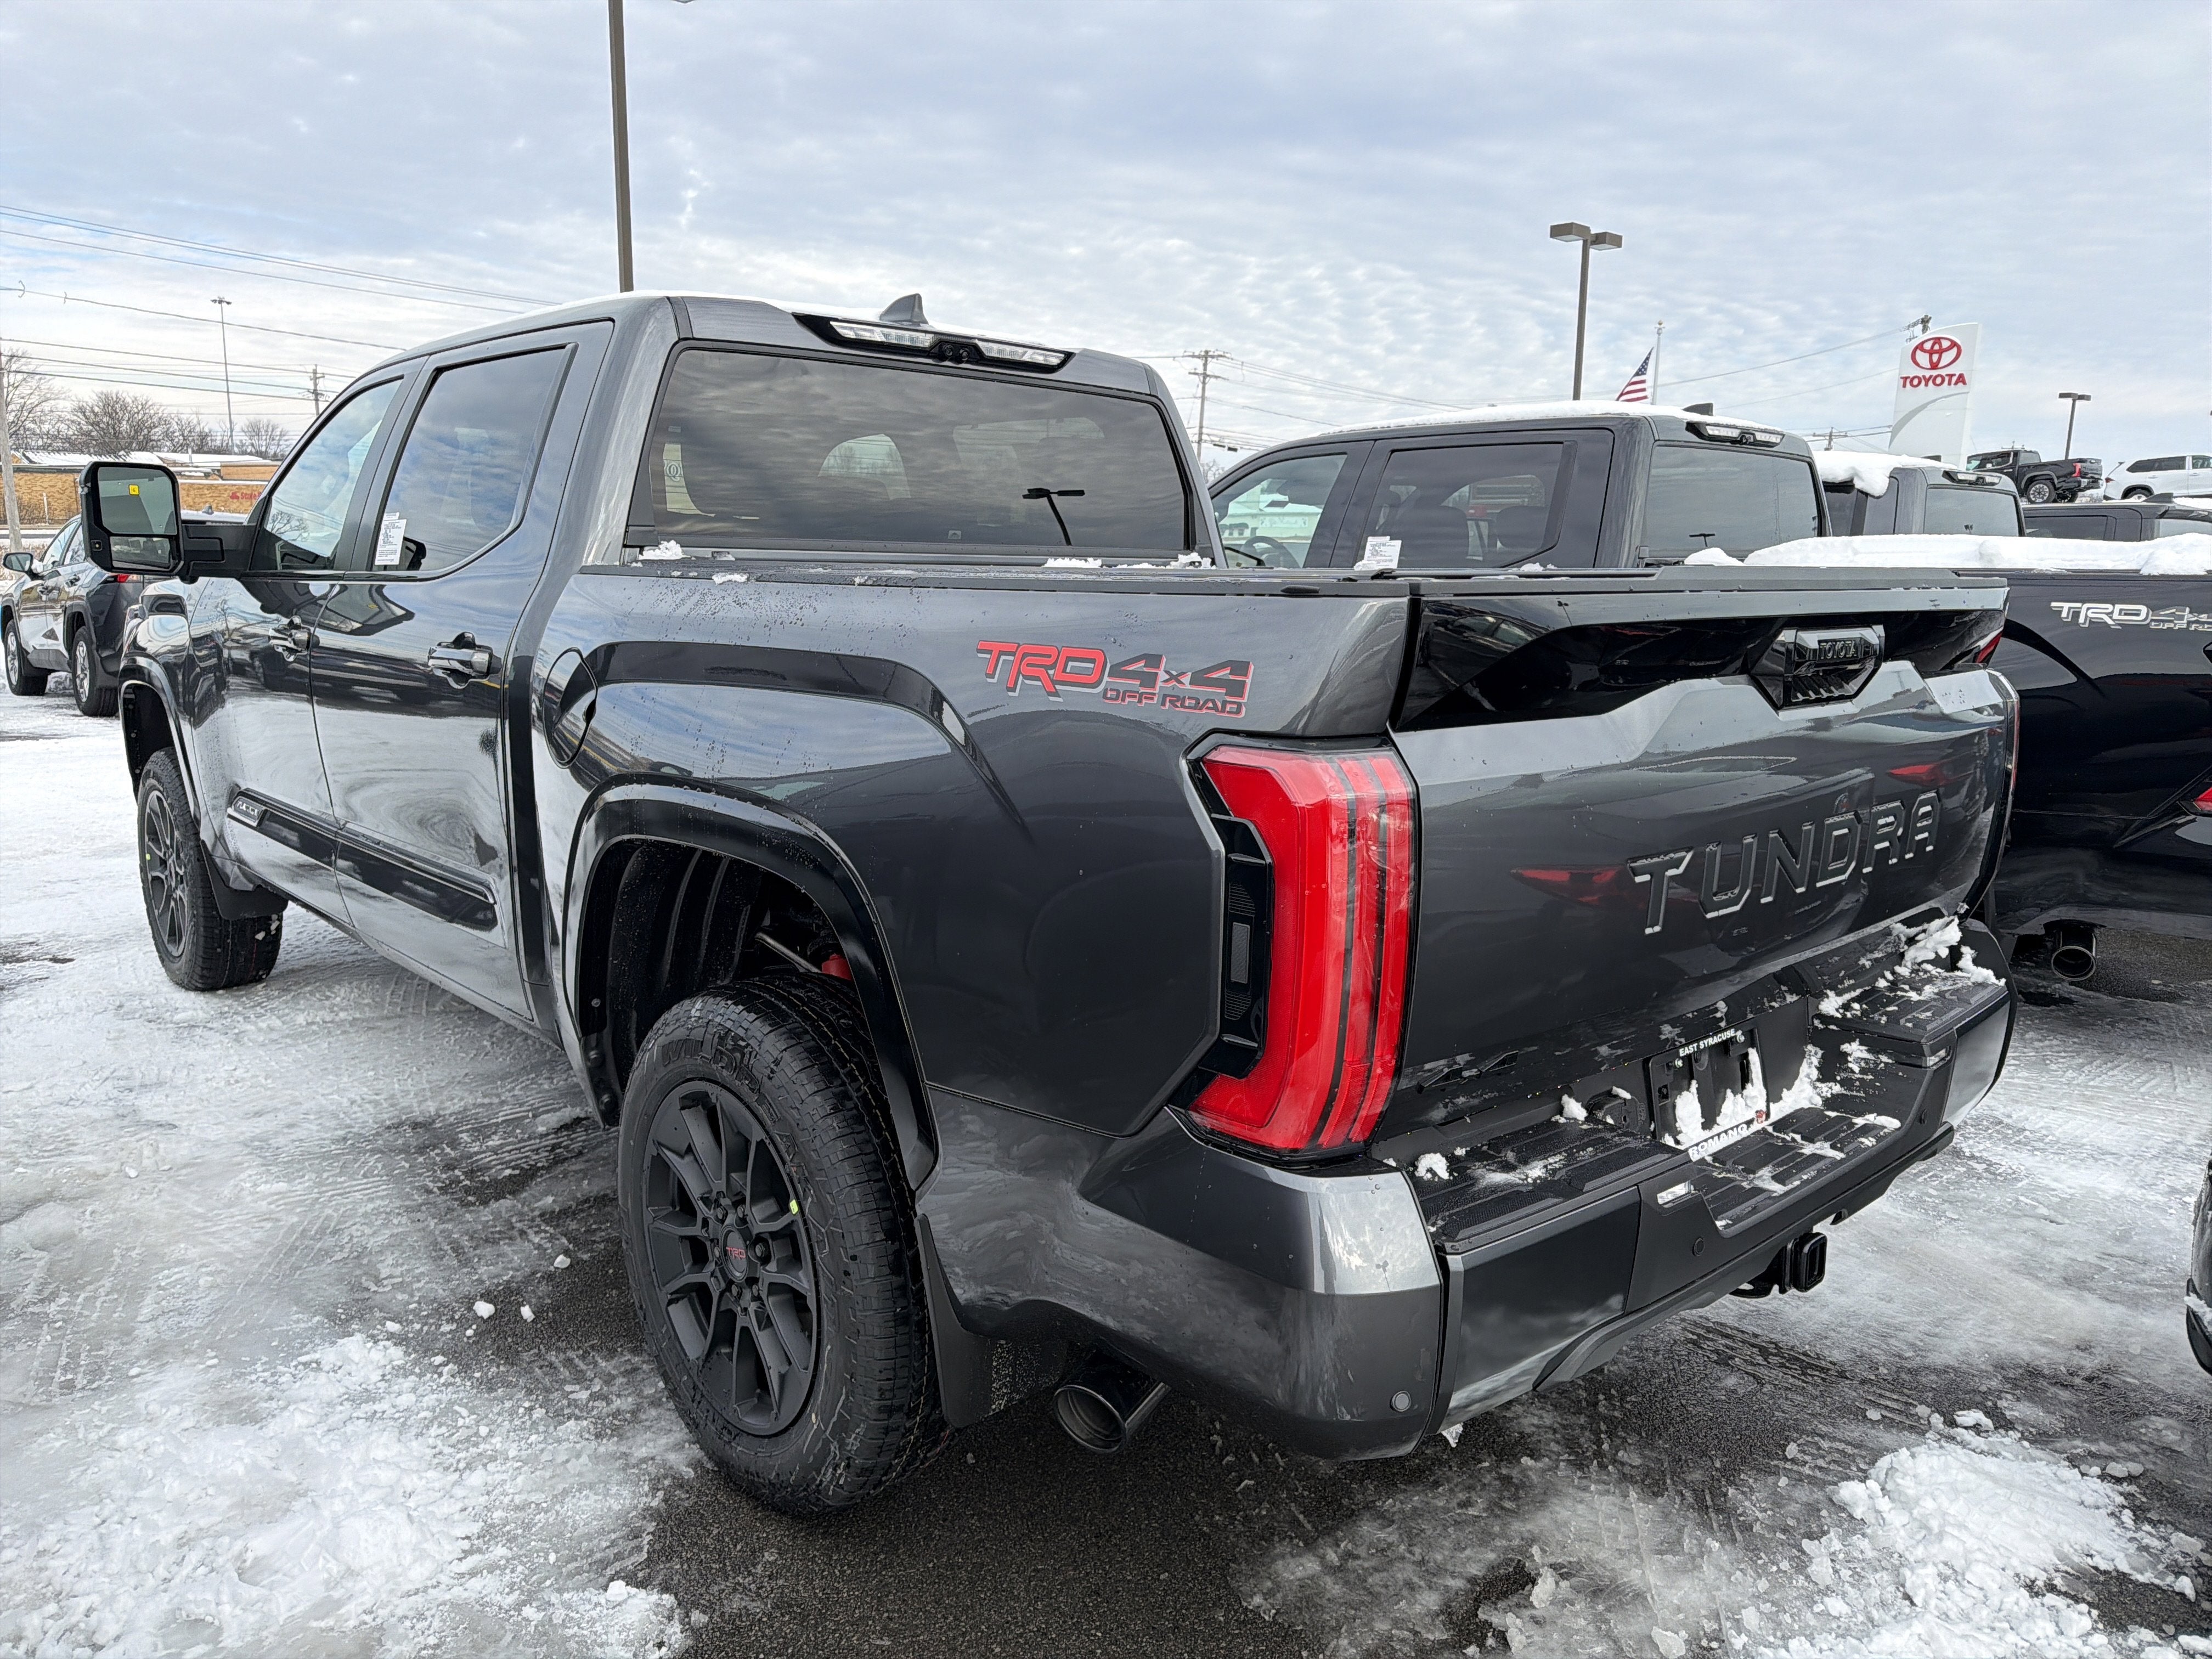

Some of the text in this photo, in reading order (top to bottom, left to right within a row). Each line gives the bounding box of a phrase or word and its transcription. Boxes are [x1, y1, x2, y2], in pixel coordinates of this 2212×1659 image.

[1900, 373, 1967, 388] TOYOTA
[2050, 602, 2212, 629] TRD 4x
[1819, 641, 1858, 659] TOYOTA
[976, 640, 1254, 702] TRD 4x4
[1102, 687, 1246, 719] OFF ROAD
[1627, 789, 1942, 934] TUNDRA
[1679, 1028, 1735, 1057] EAST SYRACUSE
[1689, 1123, 1747, 1161] ROMANO
[725, 1246, 747, 1260] TRD
